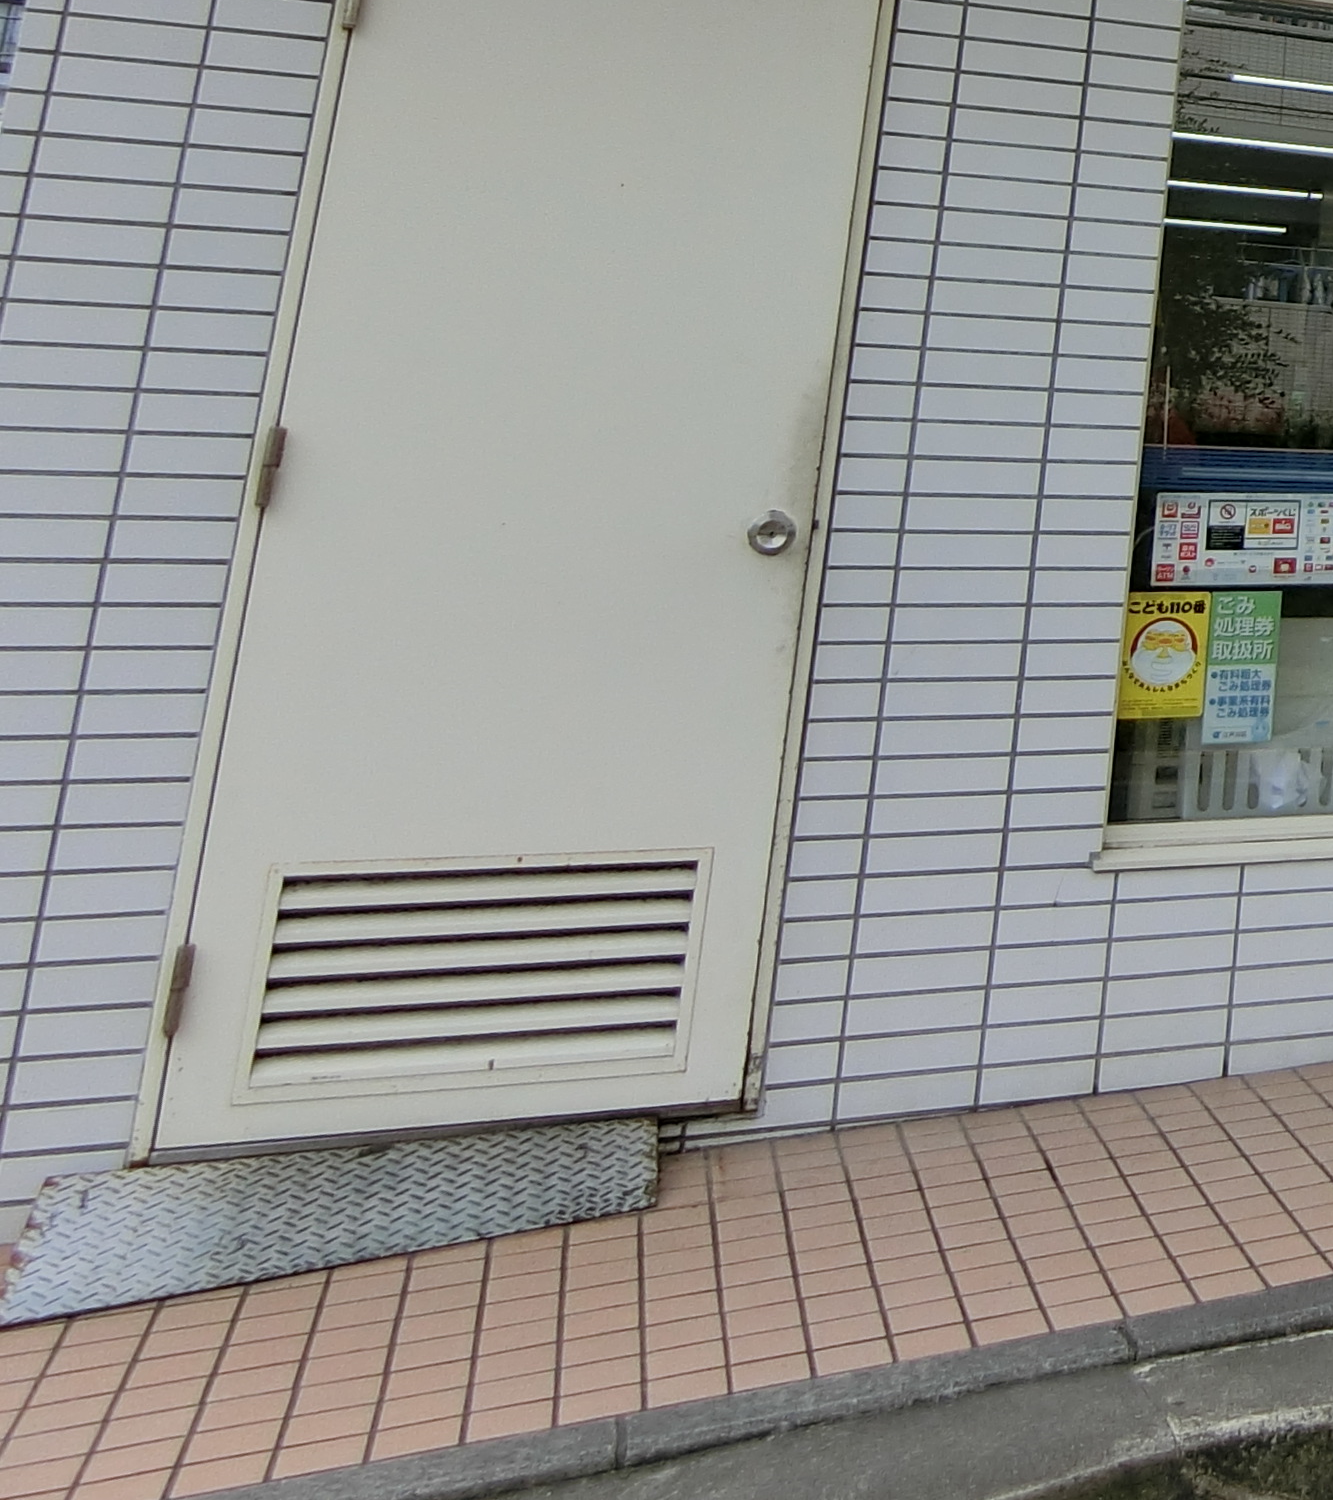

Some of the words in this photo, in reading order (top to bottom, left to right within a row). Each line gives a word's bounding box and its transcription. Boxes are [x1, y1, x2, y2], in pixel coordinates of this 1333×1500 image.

[1128, 599, 1207, 615] こども110番
[1217, 596, 1256, 615] ごみ
[1213, 615, 1275, 637] 処理券
[1211, 639, 1274, 660] 取扱所
